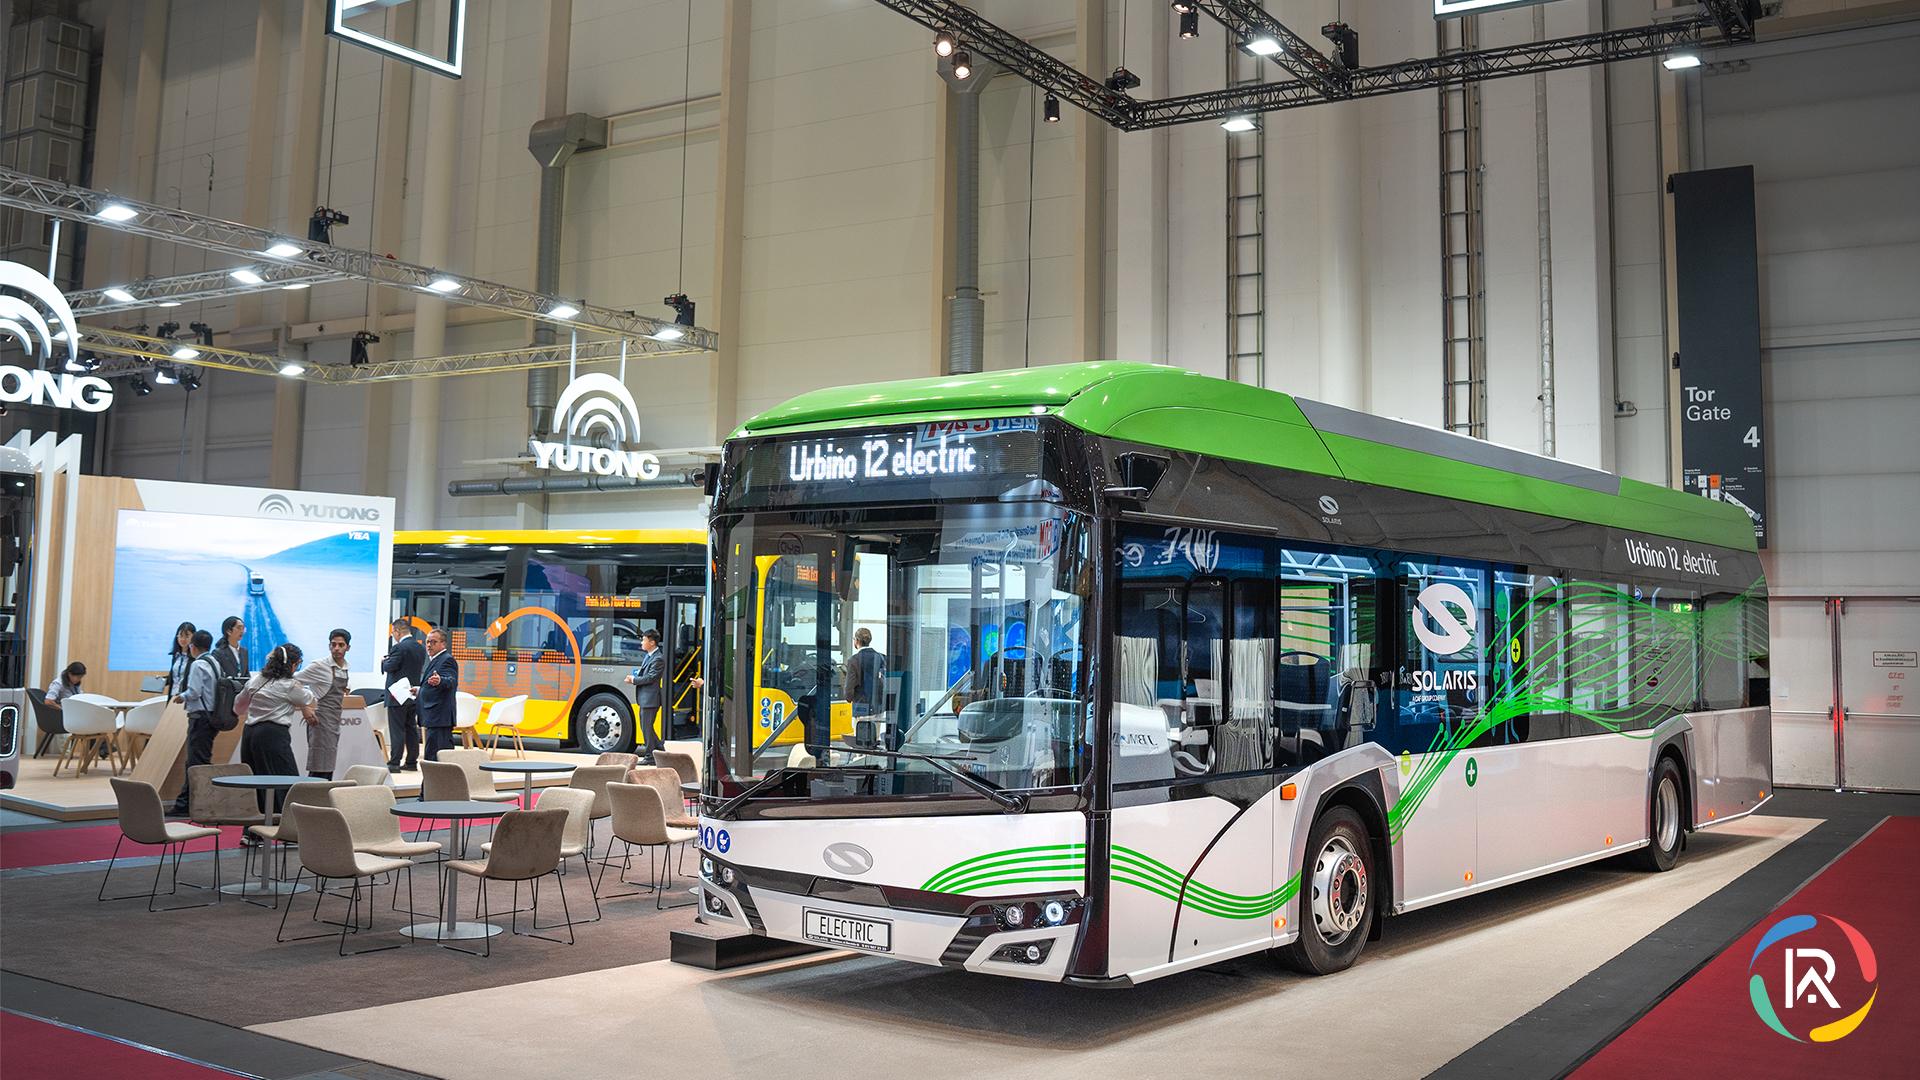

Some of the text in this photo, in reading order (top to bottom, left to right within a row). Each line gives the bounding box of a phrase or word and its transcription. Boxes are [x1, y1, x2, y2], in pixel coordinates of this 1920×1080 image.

[1685, 387, 1715, 402] Tor
[1686, 405, 1731, 421] Gate
[1743, 426, 1760, 447] 4
[530, 440, 660, 480] YUTONG
[789, 435, 976, 481] Urbino 12 electric
[300, 504, 379, 521] YUTONG
[1625, 538, 1720, 576] Urbino 12 electric
[1412, 670, 1477, 691] SOLARIS
[820, 916, 874, 942] ELECTRIC
